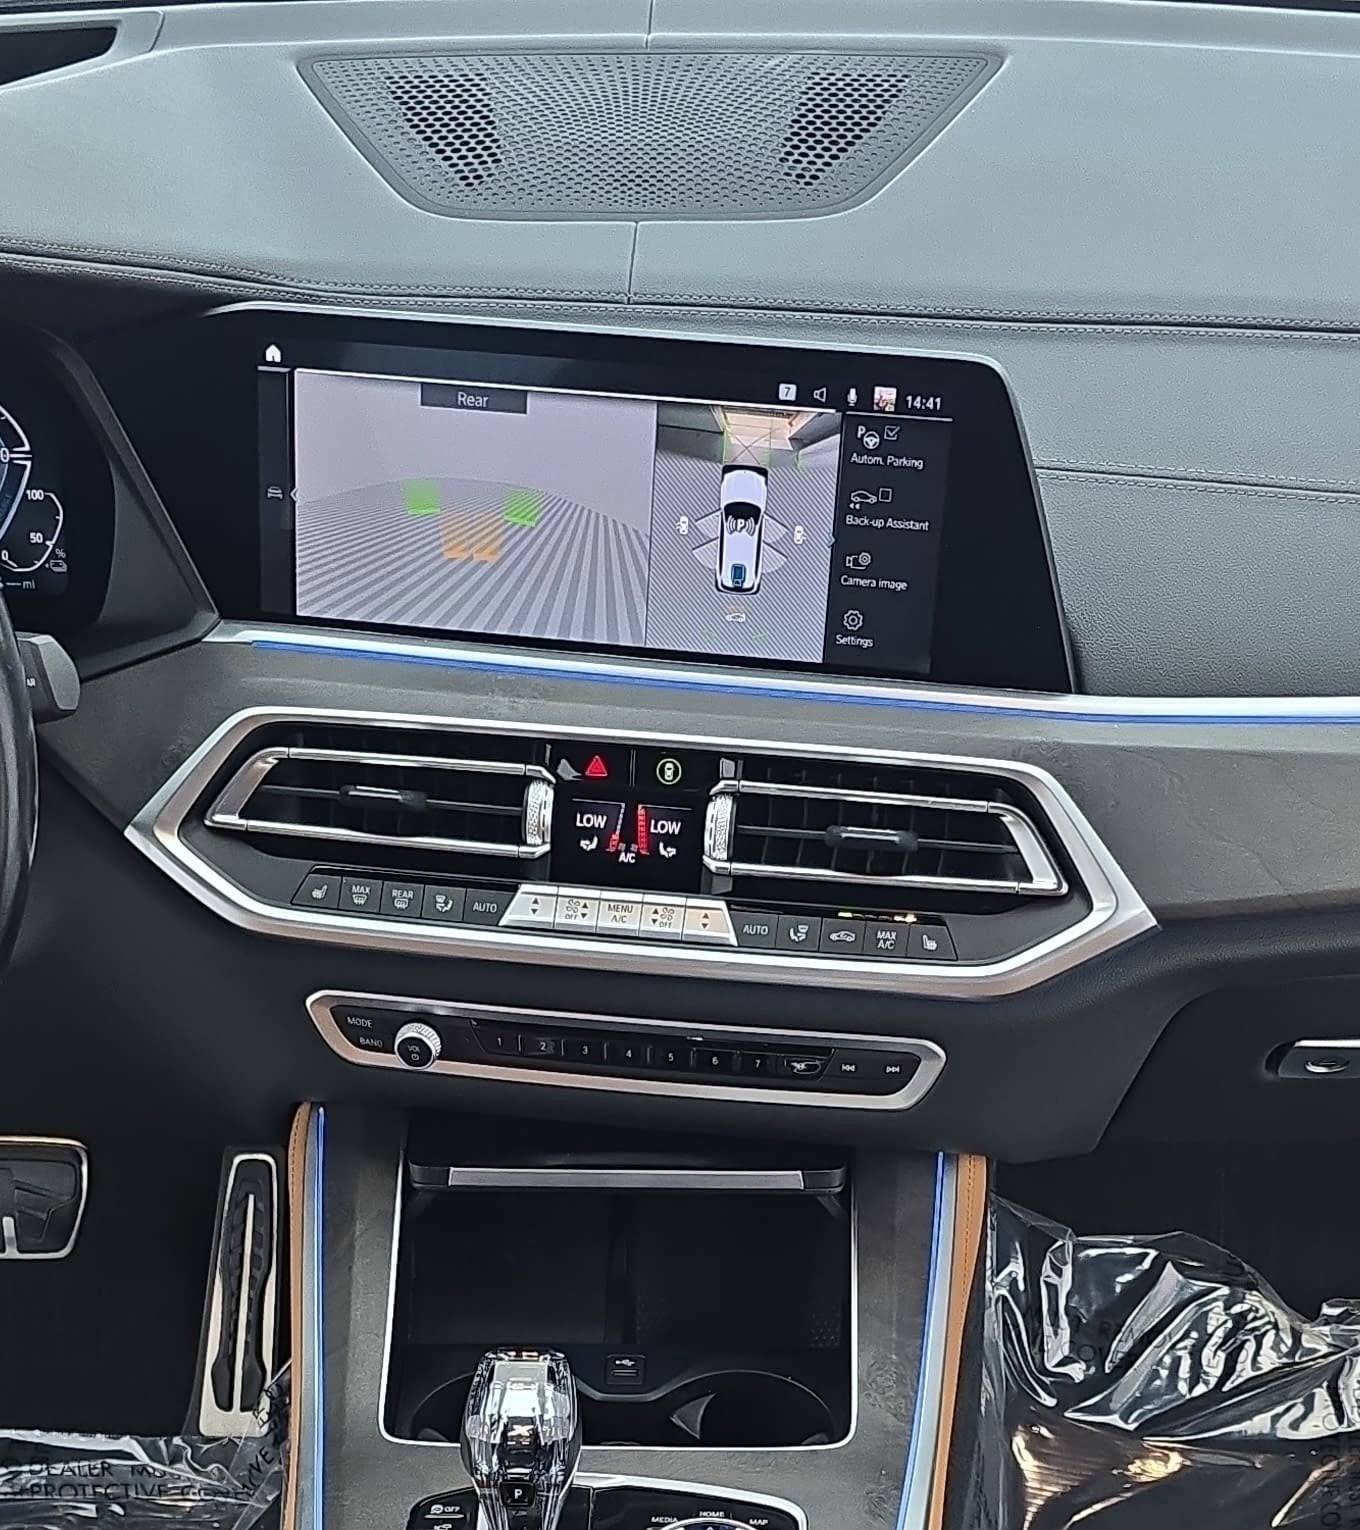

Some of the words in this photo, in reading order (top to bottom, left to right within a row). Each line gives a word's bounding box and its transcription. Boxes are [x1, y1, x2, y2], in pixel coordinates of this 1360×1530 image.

[457, 391, 489, 408] Rear
[905, 394, 942, 411] 14:41
[850, 452, 884, 467] Autom.
[886, 455, 924, 470] Parking
[25, 490, 45, 501] 100
[845, 514, 885, 530] Back-up
[885, 516, 930, 532] Assistant
[29, 532, 44, 544] 50
[1, 550, 9, 562] 0
[840, 575, 877, 589] Camera
[878, 577, 908, 592] image
[835, 634, 874, 649] Settings
[575, 812, 608, 829] LOW
[649, 819, 682, 836] LOW
[618, 851, 637, 864] A/C
[351, 885, 371, 896] MAX
[391, 888, 414, 900] REAR
[472, 901, 498, 914] AUTO
[607, 903, 634, 915] MENU
[610, 913, 628, 925] A/C
[742, 923, 769, 936] AUTO
[876, 929, 897, 941] MAX
[876, 939, 895, 951] A/C
[346, 1015, 373, 1029] MODE
[359, 1036, 383, 1048] BAND
[514, 1488, 523, 1499] P
[748, 1518, 769, 1526] MAP
